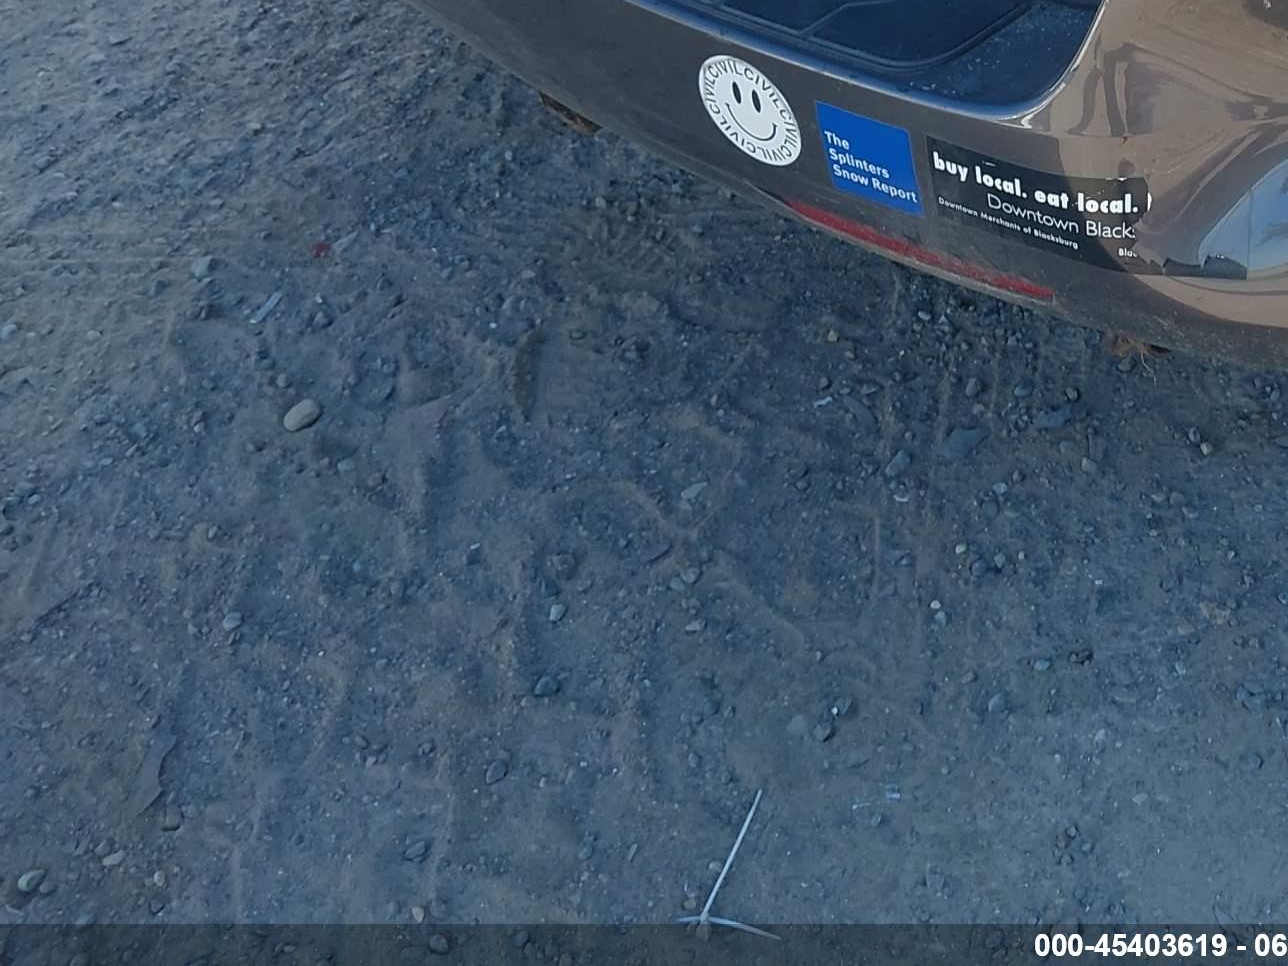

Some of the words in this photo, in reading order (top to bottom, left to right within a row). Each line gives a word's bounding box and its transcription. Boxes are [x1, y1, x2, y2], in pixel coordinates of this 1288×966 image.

[824, 130, 850, 150] The
[829, 147, 890, 179] Splinters
[933, 151, 969, 182] buy
[975, 165, 1028, 199] local.
[1034, 190, 1069, 210] eat
[1077, 192, 1138, 214] local.
[833, 164, 869, 186] Snow
[872, 177, 918, 203] Report
[938, 196, 978, 217] Downtown
[980, 211, 1021, 232] Merchants
[1022, 225, 1032, 235] of
[1033, 228, 1079, 250] Blacksburg
[987, 193, 1080, 234] Downtown
